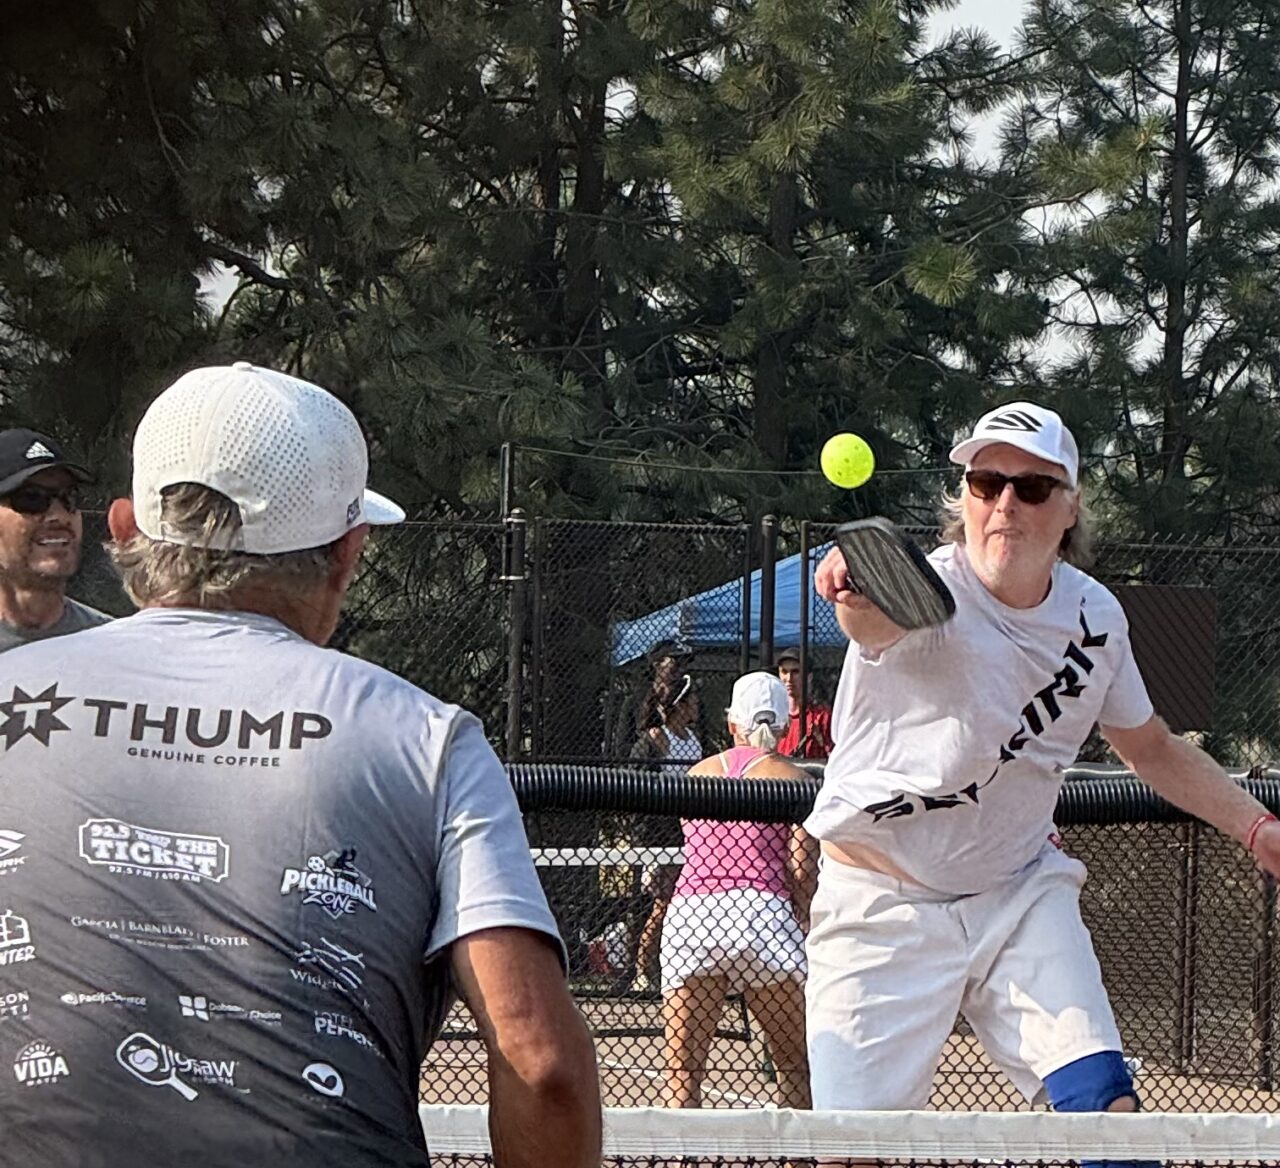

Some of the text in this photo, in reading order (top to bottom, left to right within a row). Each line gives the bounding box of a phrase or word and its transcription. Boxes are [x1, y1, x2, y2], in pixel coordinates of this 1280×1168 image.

[83, 697, 333, 750] THUMP
[127, 747, 281, 768] GENUINE COFFEE
[90, 837, 218, 877] TICKET
[175, 838, 218, 856] THE
[182, 873, 201, 883] AM
[279, 868, 379, 912] PICKLEBALL
[302, 889, 358, 914] ZONE
[203, 934, 250, 947] FOSTER
[13, 1056, 70, 1082] VIDA
